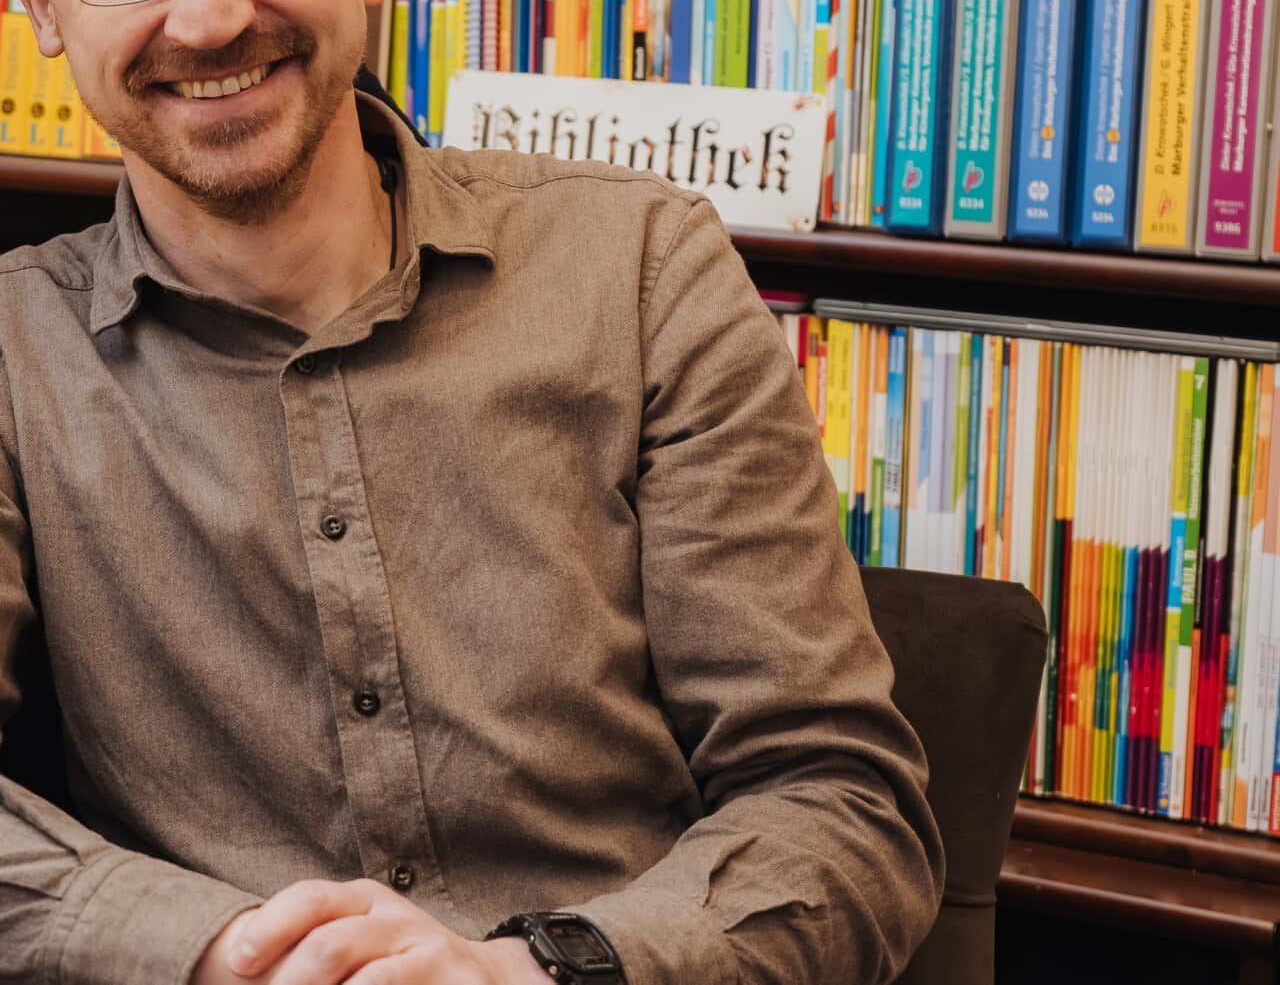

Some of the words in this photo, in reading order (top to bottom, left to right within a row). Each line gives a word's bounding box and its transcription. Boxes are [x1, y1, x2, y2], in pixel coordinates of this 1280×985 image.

[1161, 3, 1175, 52] Wingert
[472, 102, 795, 194] Bibliothek
[1156, 81, 1169, 156] Krowatschek
[1170, 102, 1187, 174] Marburger
